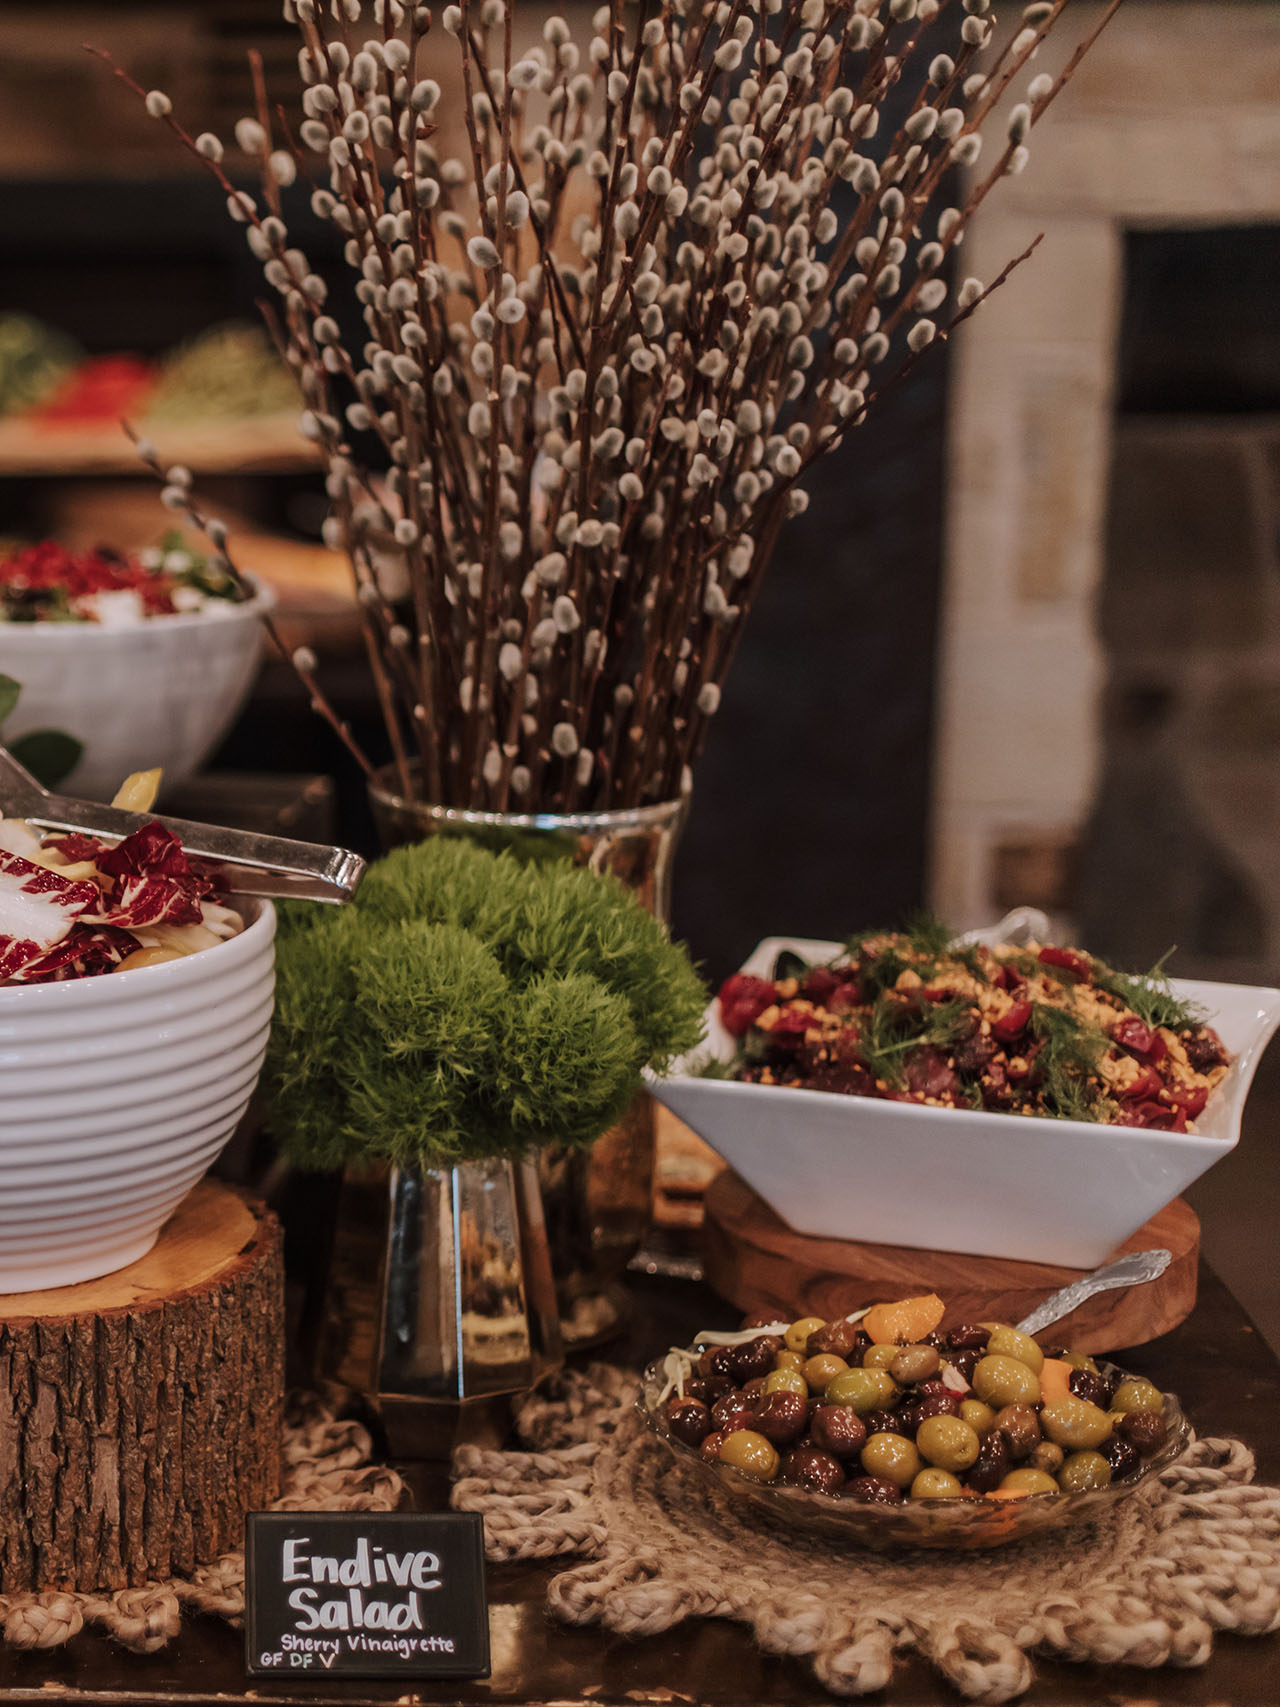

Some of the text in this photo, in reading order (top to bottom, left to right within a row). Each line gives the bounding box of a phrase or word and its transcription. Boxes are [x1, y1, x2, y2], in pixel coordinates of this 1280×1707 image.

[282, 1537, 442, 1590] Endive
[288, 1588, 423, 1631] Salad
[260, 1652, 336, 1669] GF DF V
[280, 1633, 455, 1659] Sherry Vinaigrette
